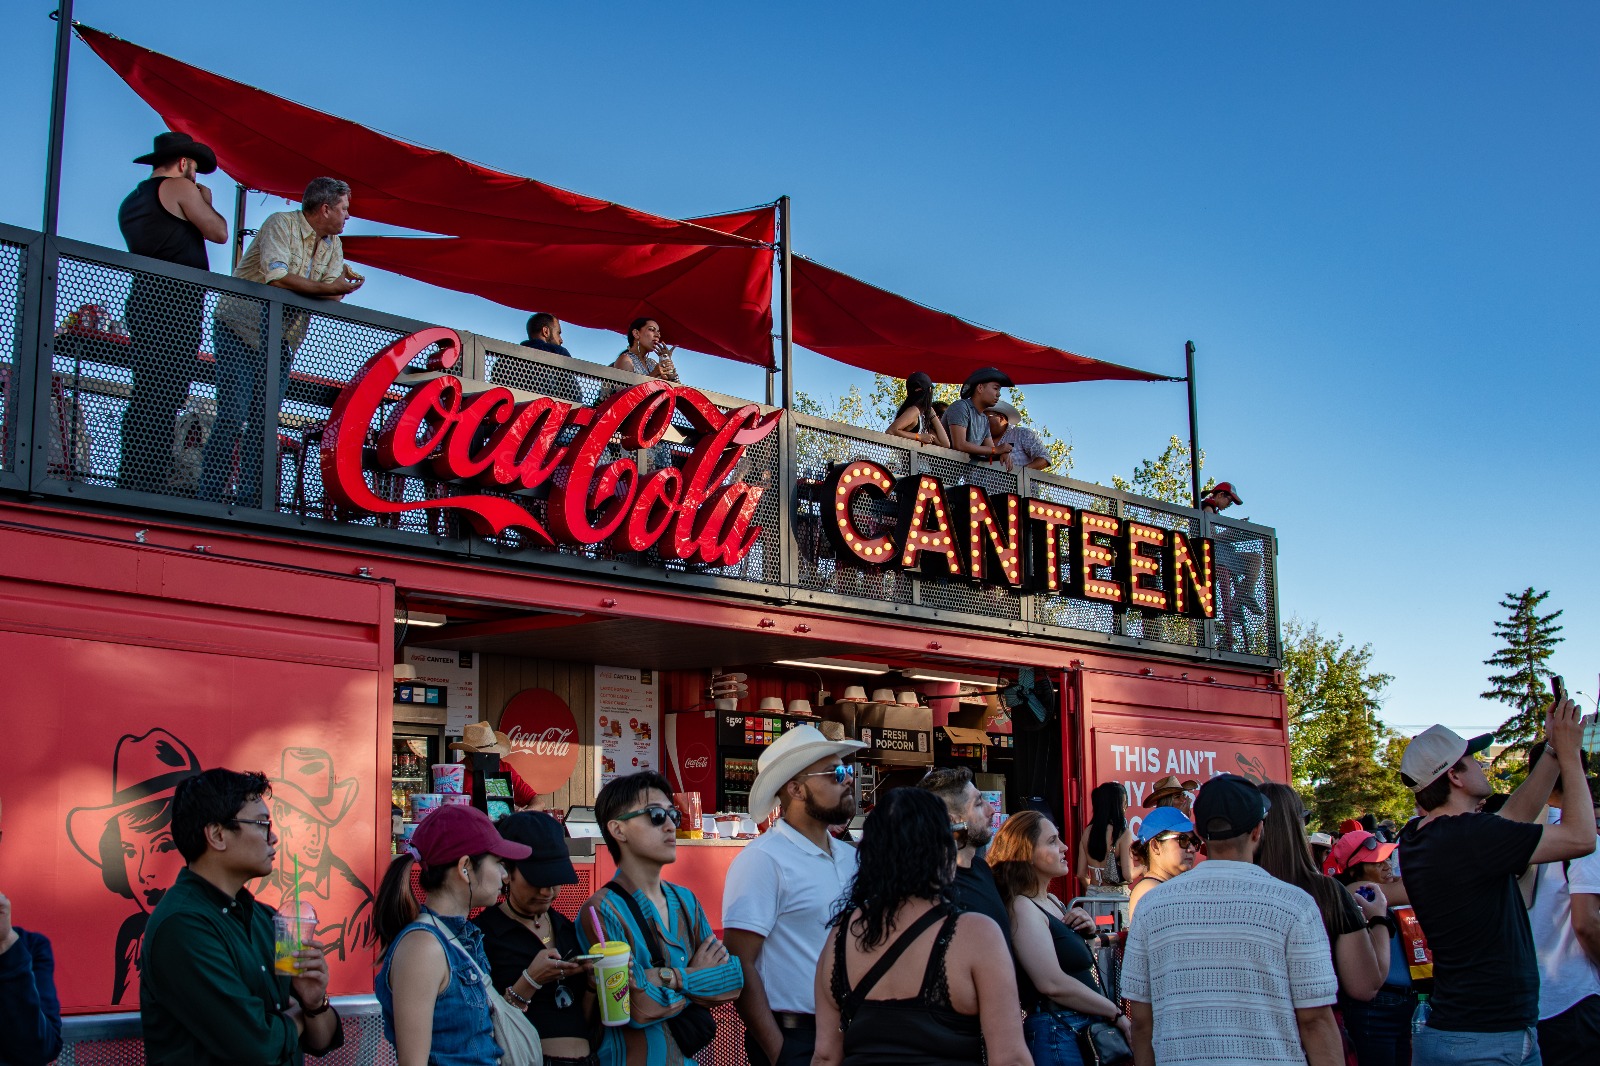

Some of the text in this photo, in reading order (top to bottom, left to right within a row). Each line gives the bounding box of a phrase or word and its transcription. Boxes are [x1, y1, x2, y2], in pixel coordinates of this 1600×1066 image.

[321, 327, 784, 567] Coca-Cola
[823, 460, 1216, 619] CANTEEN
[427, 656, 454, 664] CANTEEN
[507, 725, 573, 756] Coca-Cola
[875, 739, 914, 751] POPCORN
[882, 729, 908, 740] FRESH
[1110, 745, 1217, 776] THIS AIN'T
